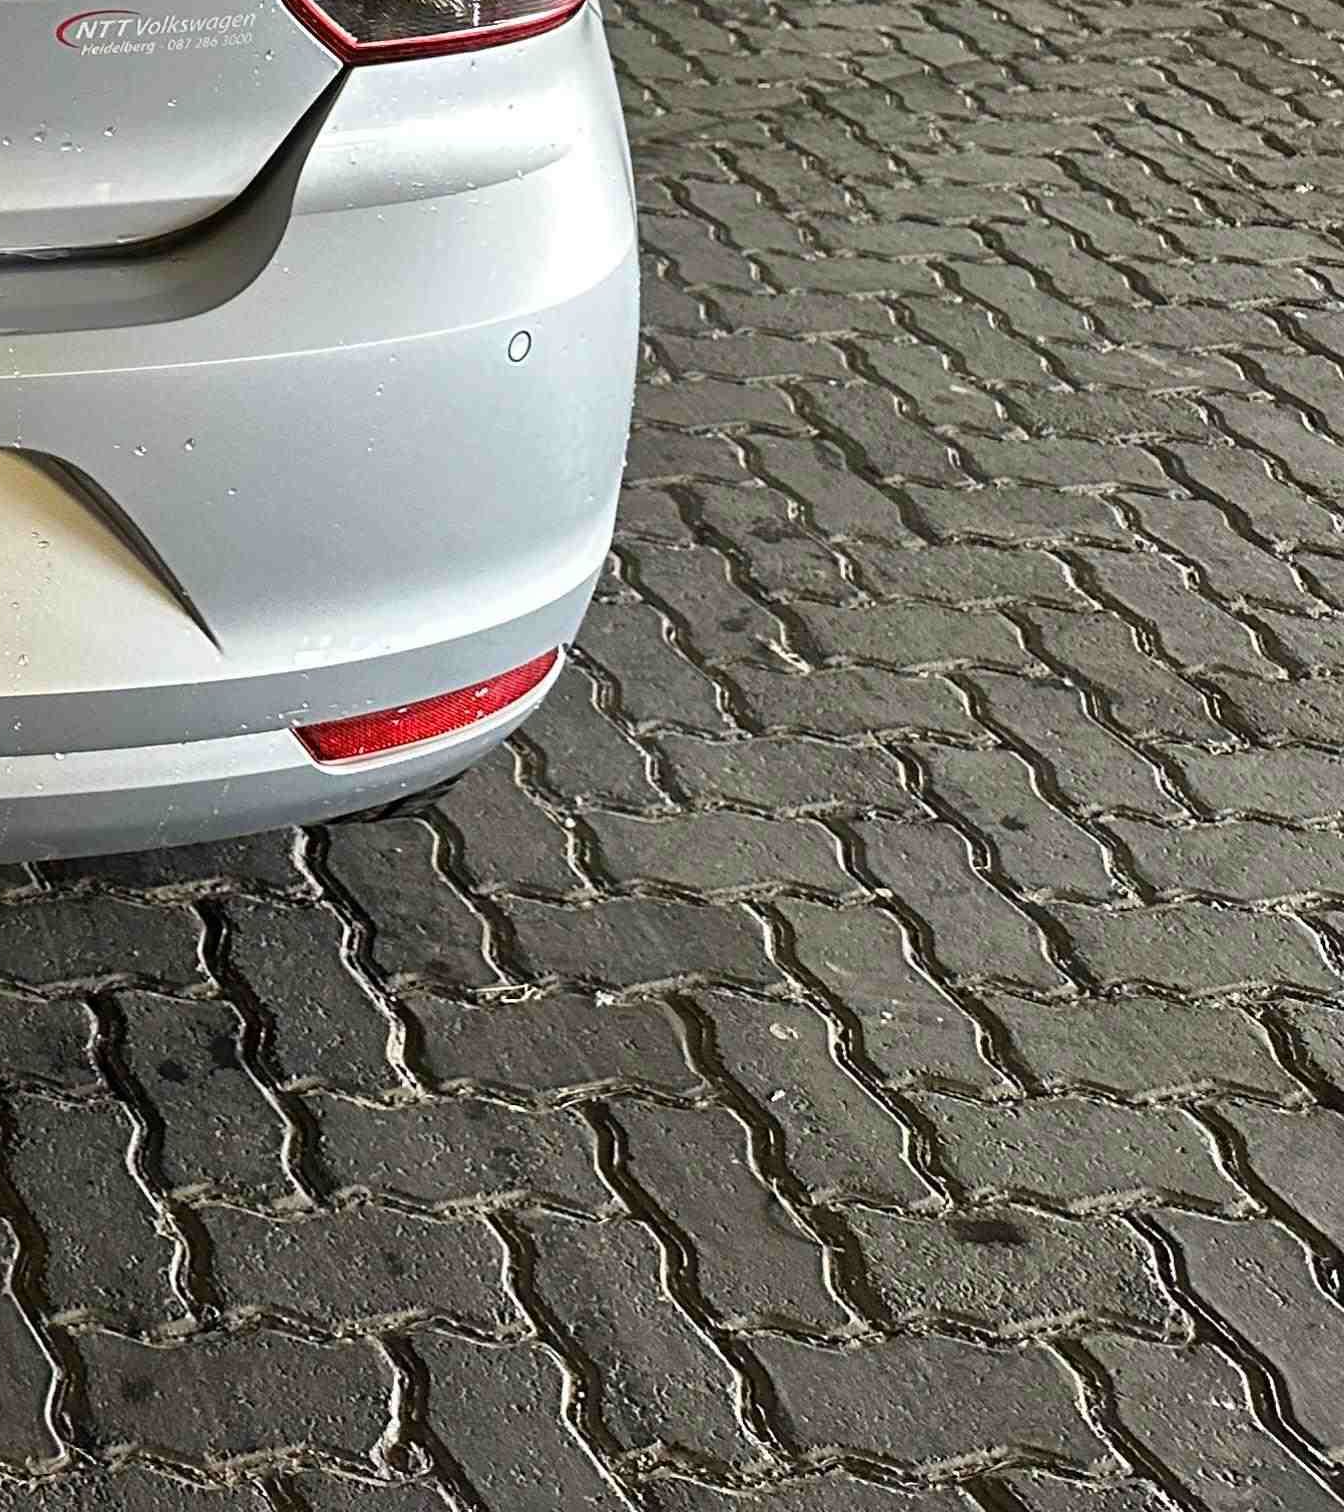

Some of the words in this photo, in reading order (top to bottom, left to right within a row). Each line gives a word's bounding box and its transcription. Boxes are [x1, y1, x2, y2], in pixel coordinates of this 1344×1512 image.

[75, 19, 134, 39] NTT
[136, 12, 257, 37] Volkswagen
[81, 40, 155, 56] Heidelberg
